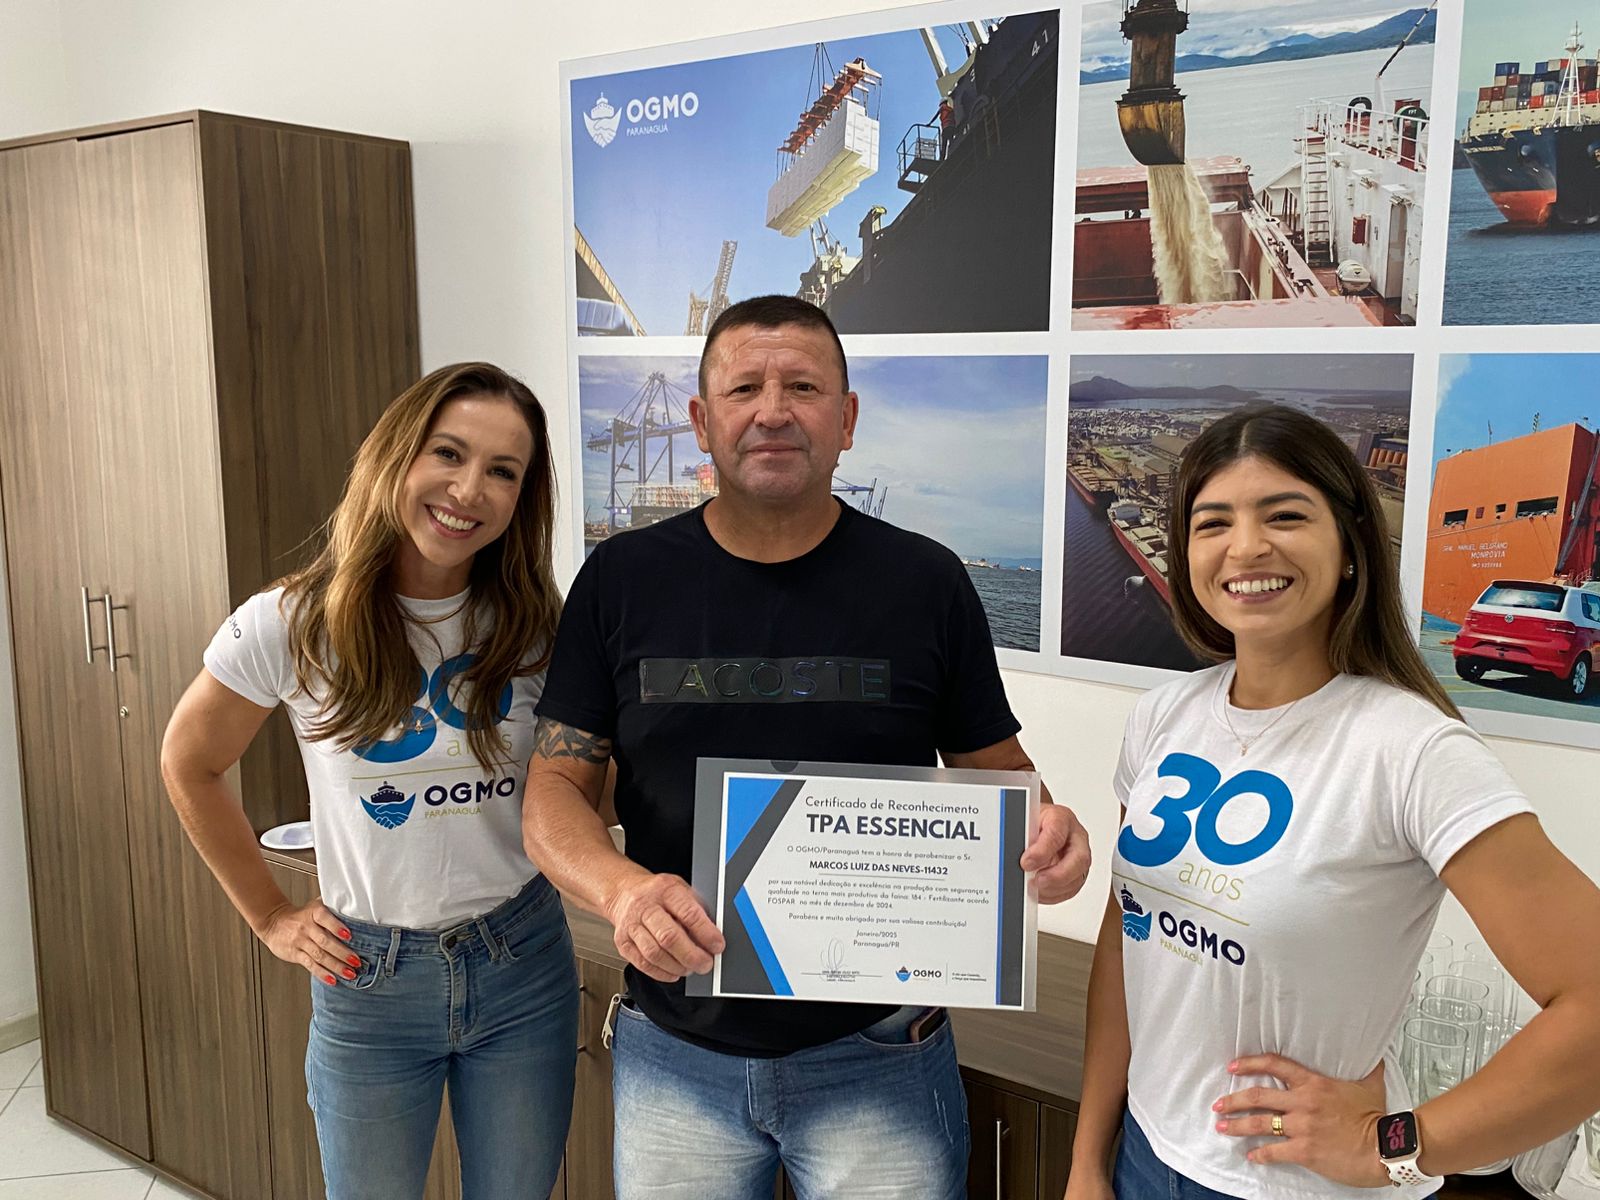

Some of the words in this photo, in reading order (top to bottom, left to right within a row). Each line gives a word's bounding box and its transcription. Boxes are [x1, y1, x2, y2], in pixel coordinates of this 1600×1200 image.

[626, 92, 699, 123] OGMO
[641, 661, 887, 698] LACOSTE
[424, 776, 516, 806] OGMO
[805, 795, 867, 809] Certificado
[870, 797, 885, 810] de
[888, 799, 979, 815] Reconhecimento
[1117, 752, 1294, 867] 30
[806, 813, 851, 834] TPA
[857, 815, 981, 841] ESSENCIAL
[809, 860, 849, 870] MARCOS
[850, 862, 870, 871] LUIZ
[872, 863, 890, 872] DAS
[892, 864, 949, 875] NEVES-11432
[882, 849, 902, 857] honra
[903, 850, 913, 858] de
[1178, 862, 1245, 901] anos
[767, 897, 796, 905] FOSPAR
[833, 900, 865, 908] dezembro
[788, 912, 818, 920] Parabéns
[1158, 911, 1246, 966] OGMO
[913, 969, 942, 978] OGMO
